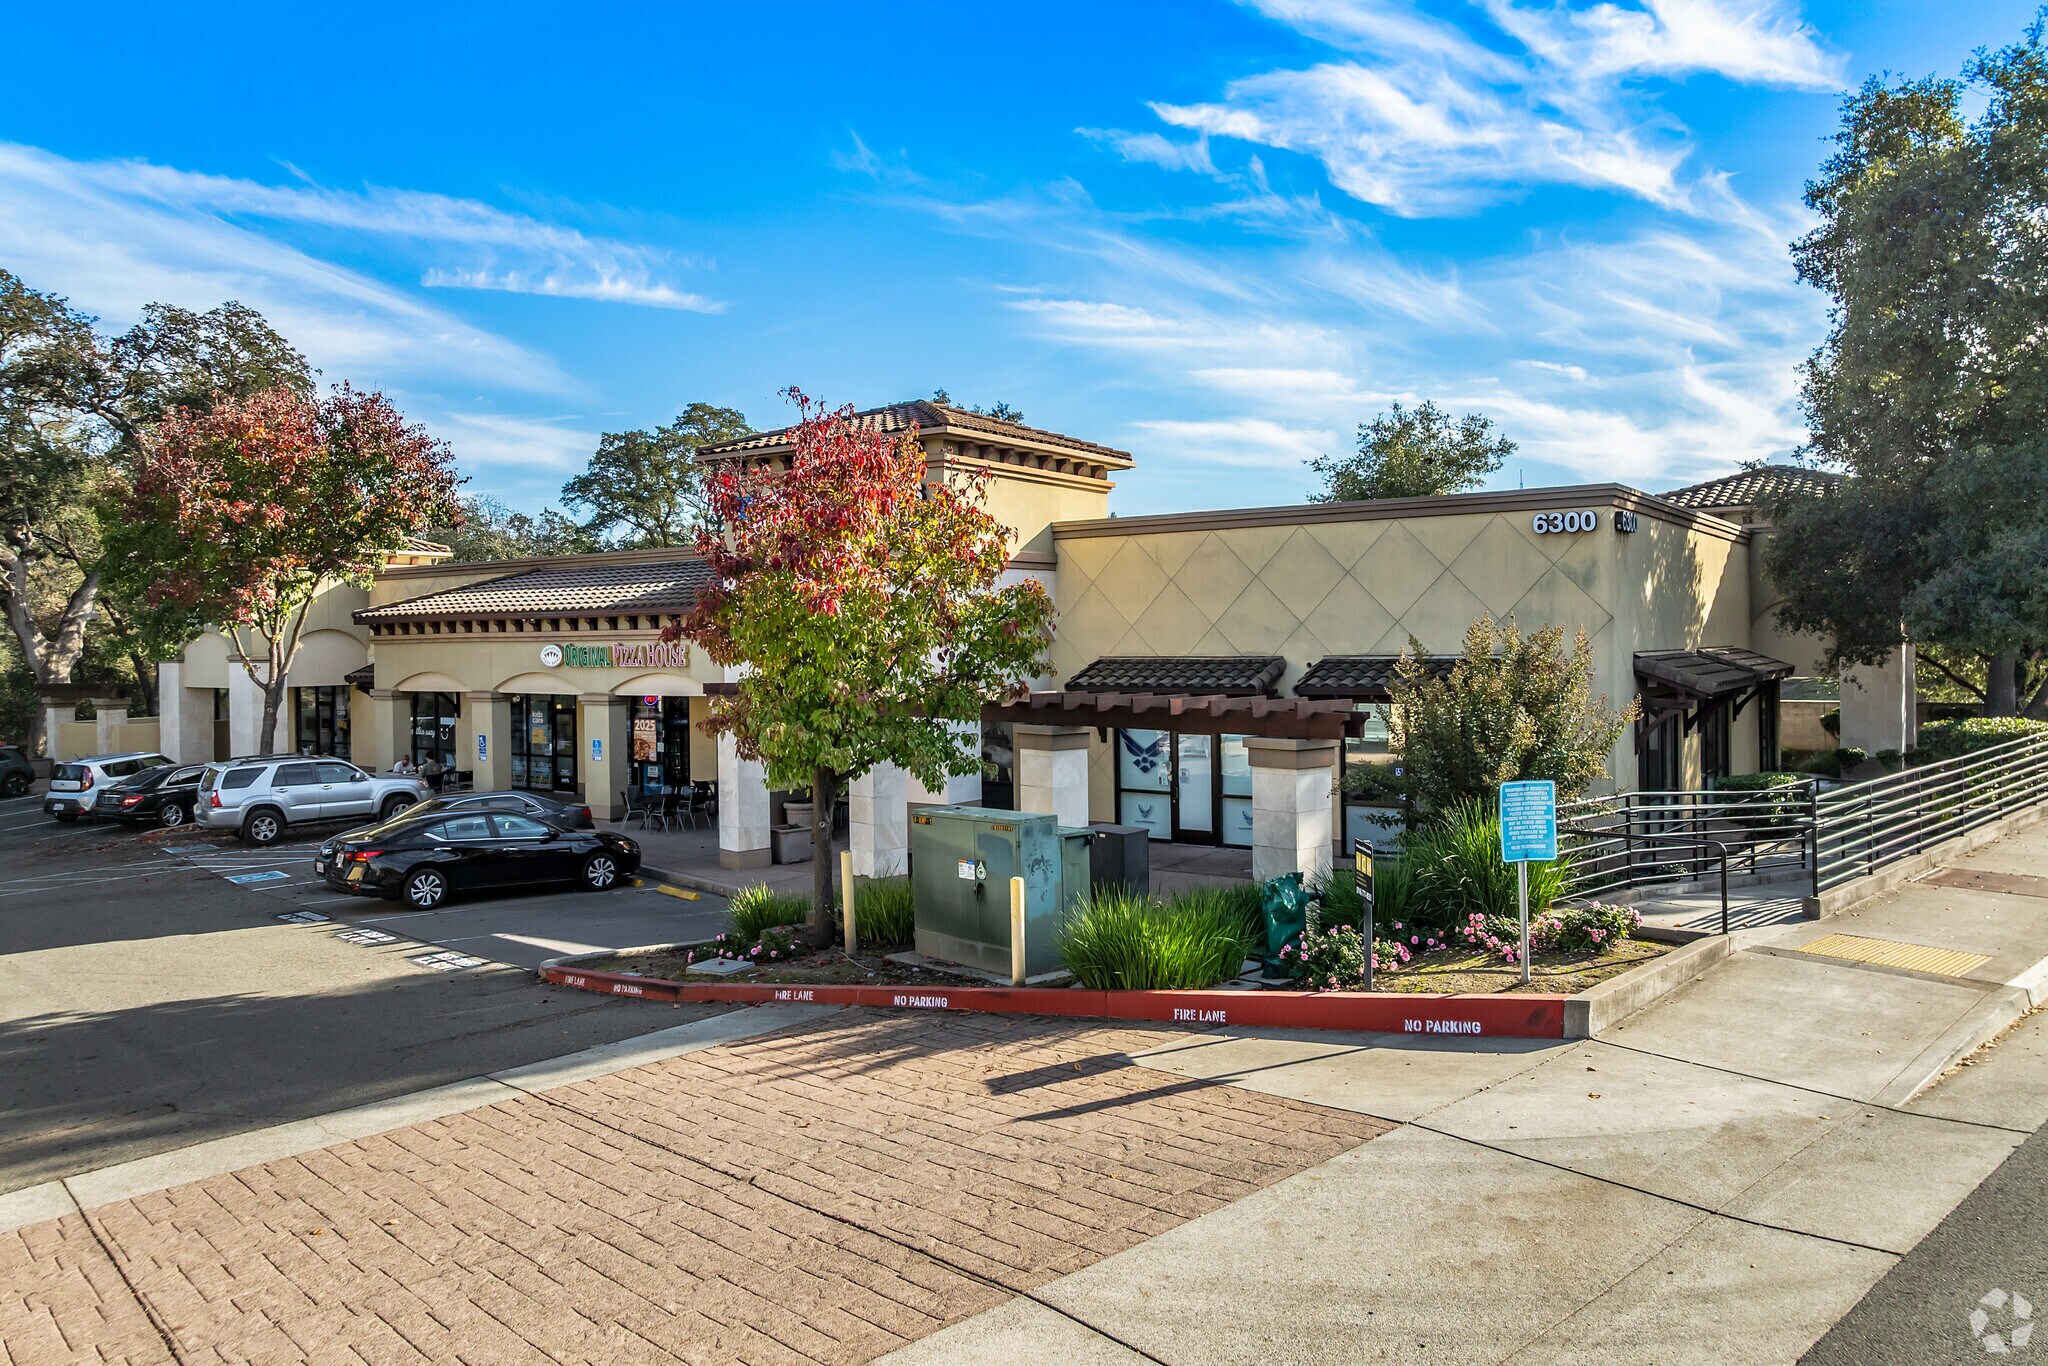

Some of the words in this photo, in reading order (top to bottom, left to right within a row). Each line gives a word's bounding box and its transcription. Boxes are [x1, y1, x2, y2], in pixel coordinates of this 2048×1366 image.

[1533, 510, 1597, 534] 6300
[564, 643, 611, 667] ORIGINAL
[612, 642, 646, 667] PIZZA
[646, 641, 686, 667] HOUSE
[531, 710, 543, 718] kids
[635, 719, 656, 731] 2025
[564, 975, 574, 985] FIRE
[574, 976, 586, 987] LANE
[613, 984, 621, 993] NO
[621, 984, 643, 995] PARKING
[775, 990, 792, 1000] FIRE
[793, 990, 814, 1001] LANE
[894, 995, 907, 1006] NO
[909, 996, 948, 1008] PARKING
[1173, 1008, 1196, 1021] FIRE
[1199, 1009, 1226, 1023] LANE
[1404, 1018, 1423, 1033] NO
[1425, 1019, 1482, 1034] PARKING
